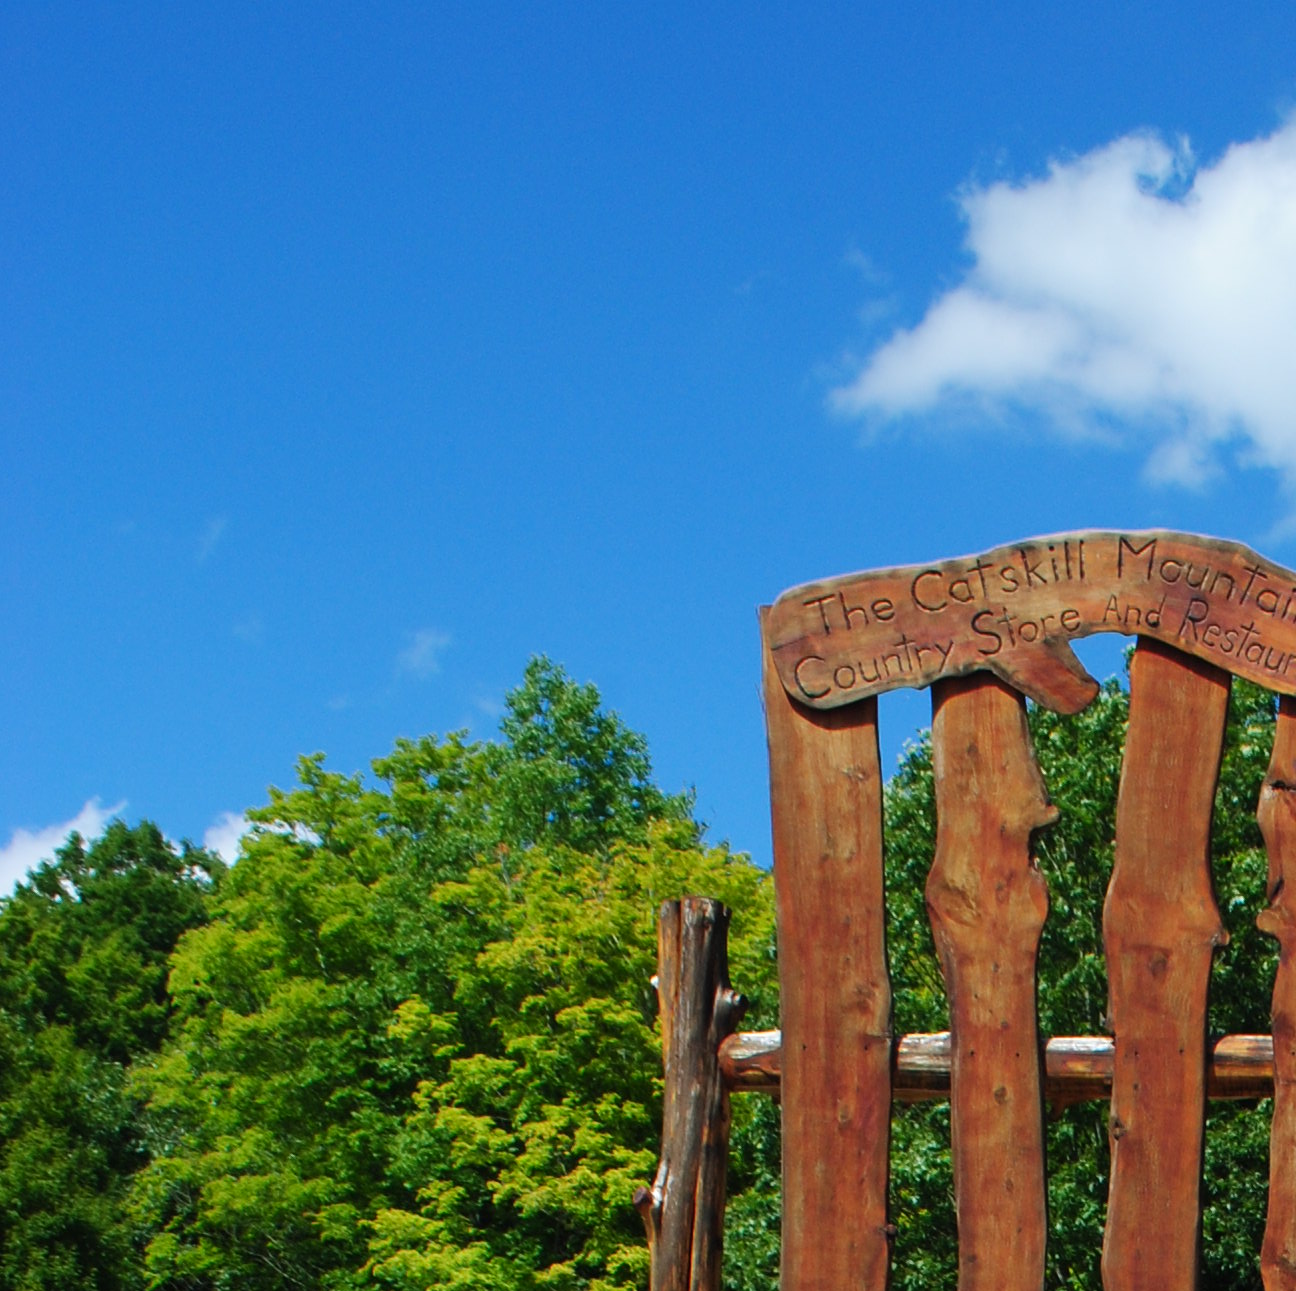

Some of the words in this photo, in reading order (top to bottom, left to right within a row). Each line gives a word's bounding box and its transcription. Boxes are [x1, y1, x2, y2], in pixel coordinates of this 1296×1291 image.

[803, 591, 895, 635] The
[910, 539, 1086, 612] Catskill
[794, 634, 954, 699] Country
[971, 606, 1081, 655] Store
[1102, 594, 1167, 628] And
